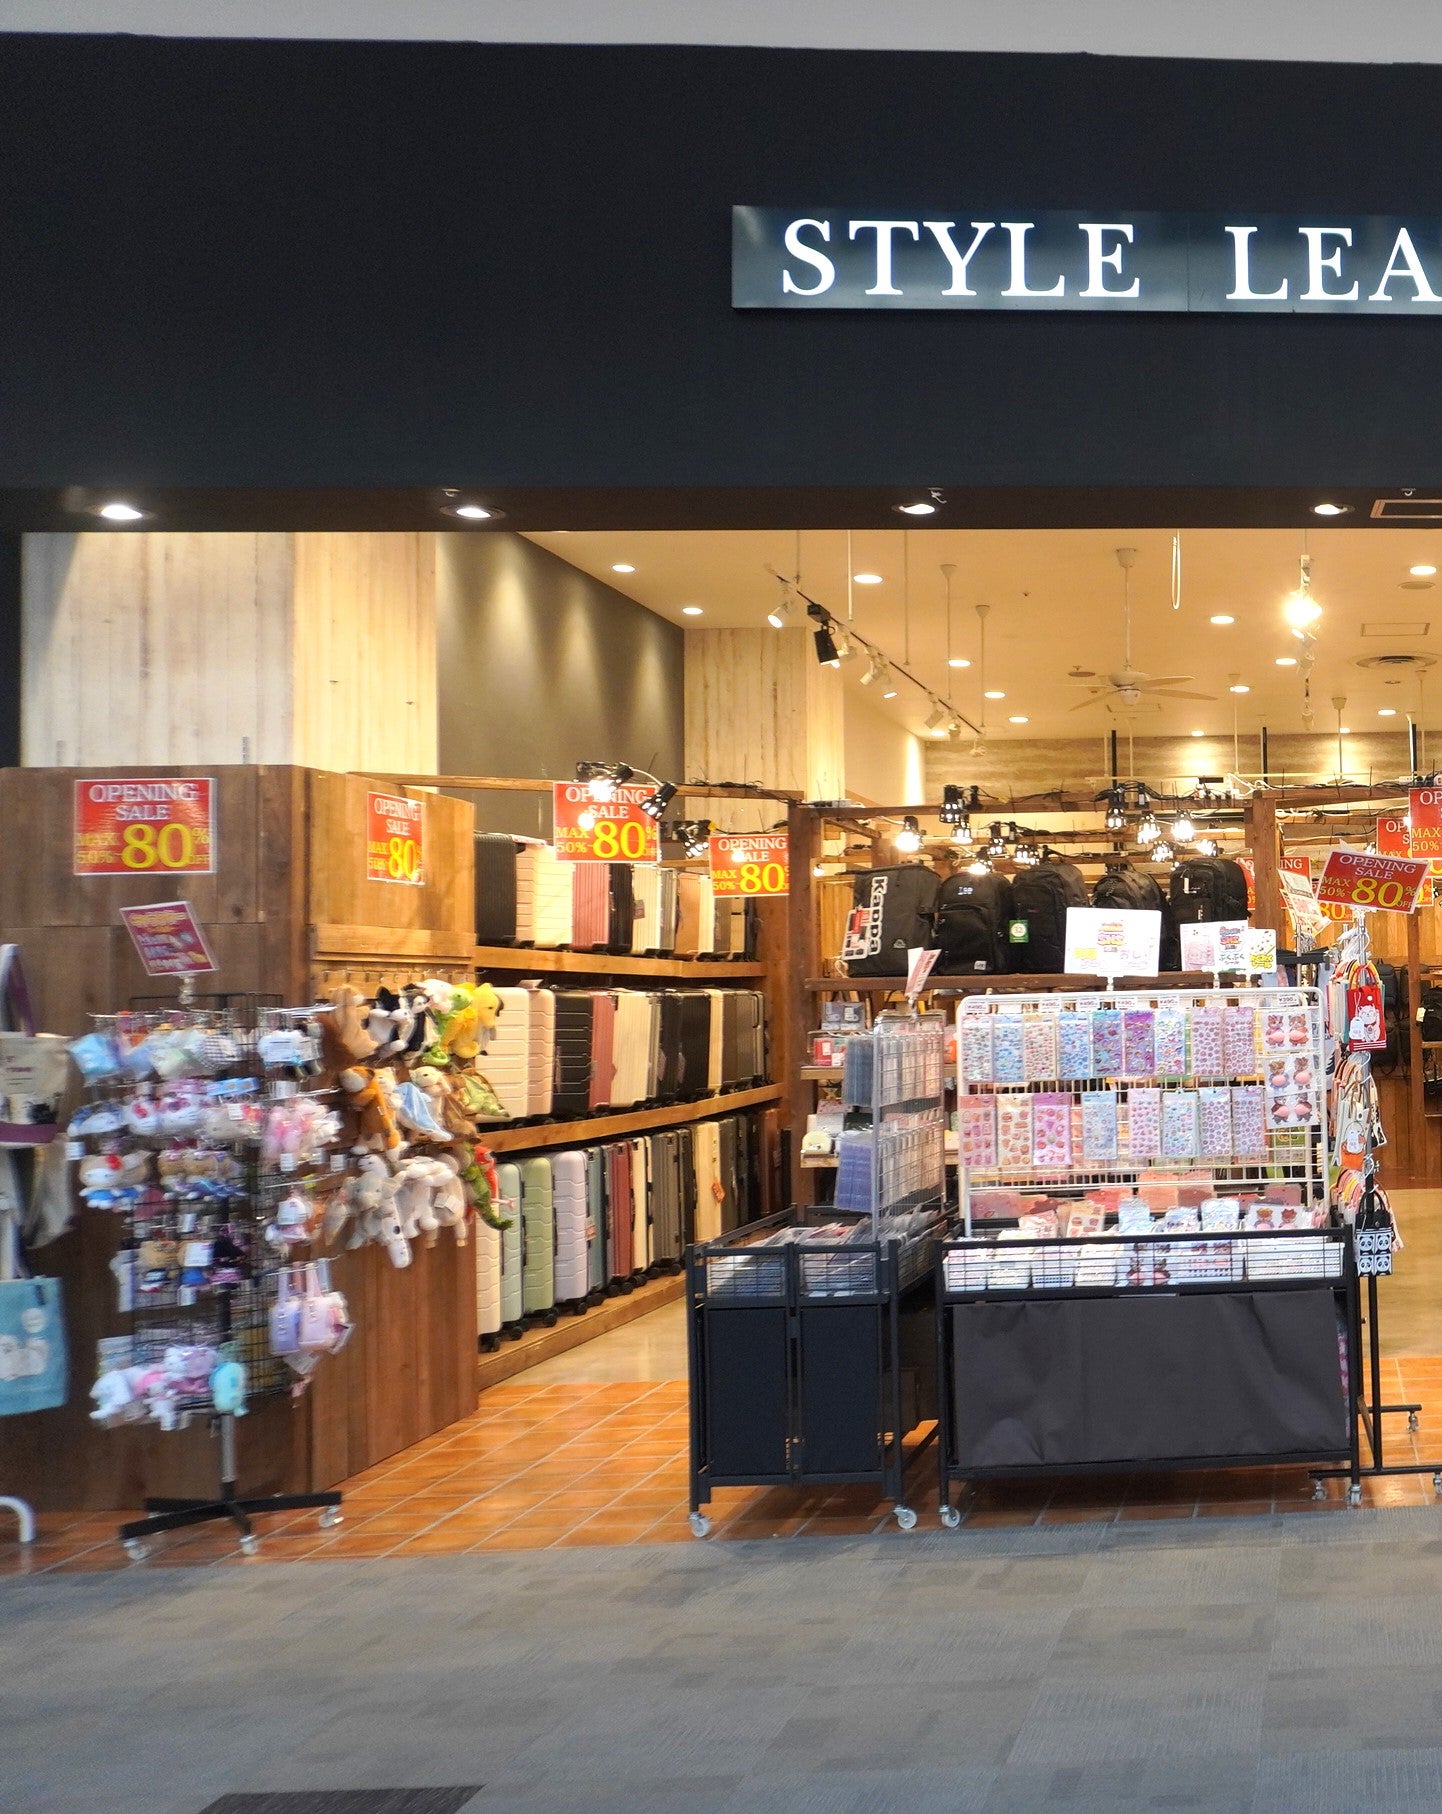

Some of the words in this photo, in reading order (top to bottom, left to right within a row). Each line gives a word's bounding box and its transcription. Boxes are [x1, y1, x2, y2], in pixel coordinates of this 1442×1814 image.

[780, 217, 1142, 299] STYLE
[88, 783, 200, 803] OPENING
[565, 786, 651, 804] OPING
[115, 804, 171, 821] SALE
[374, 797, 421, 821] OPENING
[587, 805, 630, 819] SALE
[386, 819, 412, 836] SALE
[555, 827, 590, 838] MAX
[1412, 827, 1441, 838] MAX
[718, 838, 788, 851] OPENING
[733, 851, 769, 863] ALE
[1339, 855, 1416, 873] OPENING
[711, 870, 737, 878] MAX
[1322, 875, 1351, 887] MAX
[1354, 867, 1394, 880] SALE
[868, 876, 888, 955] Kappa
